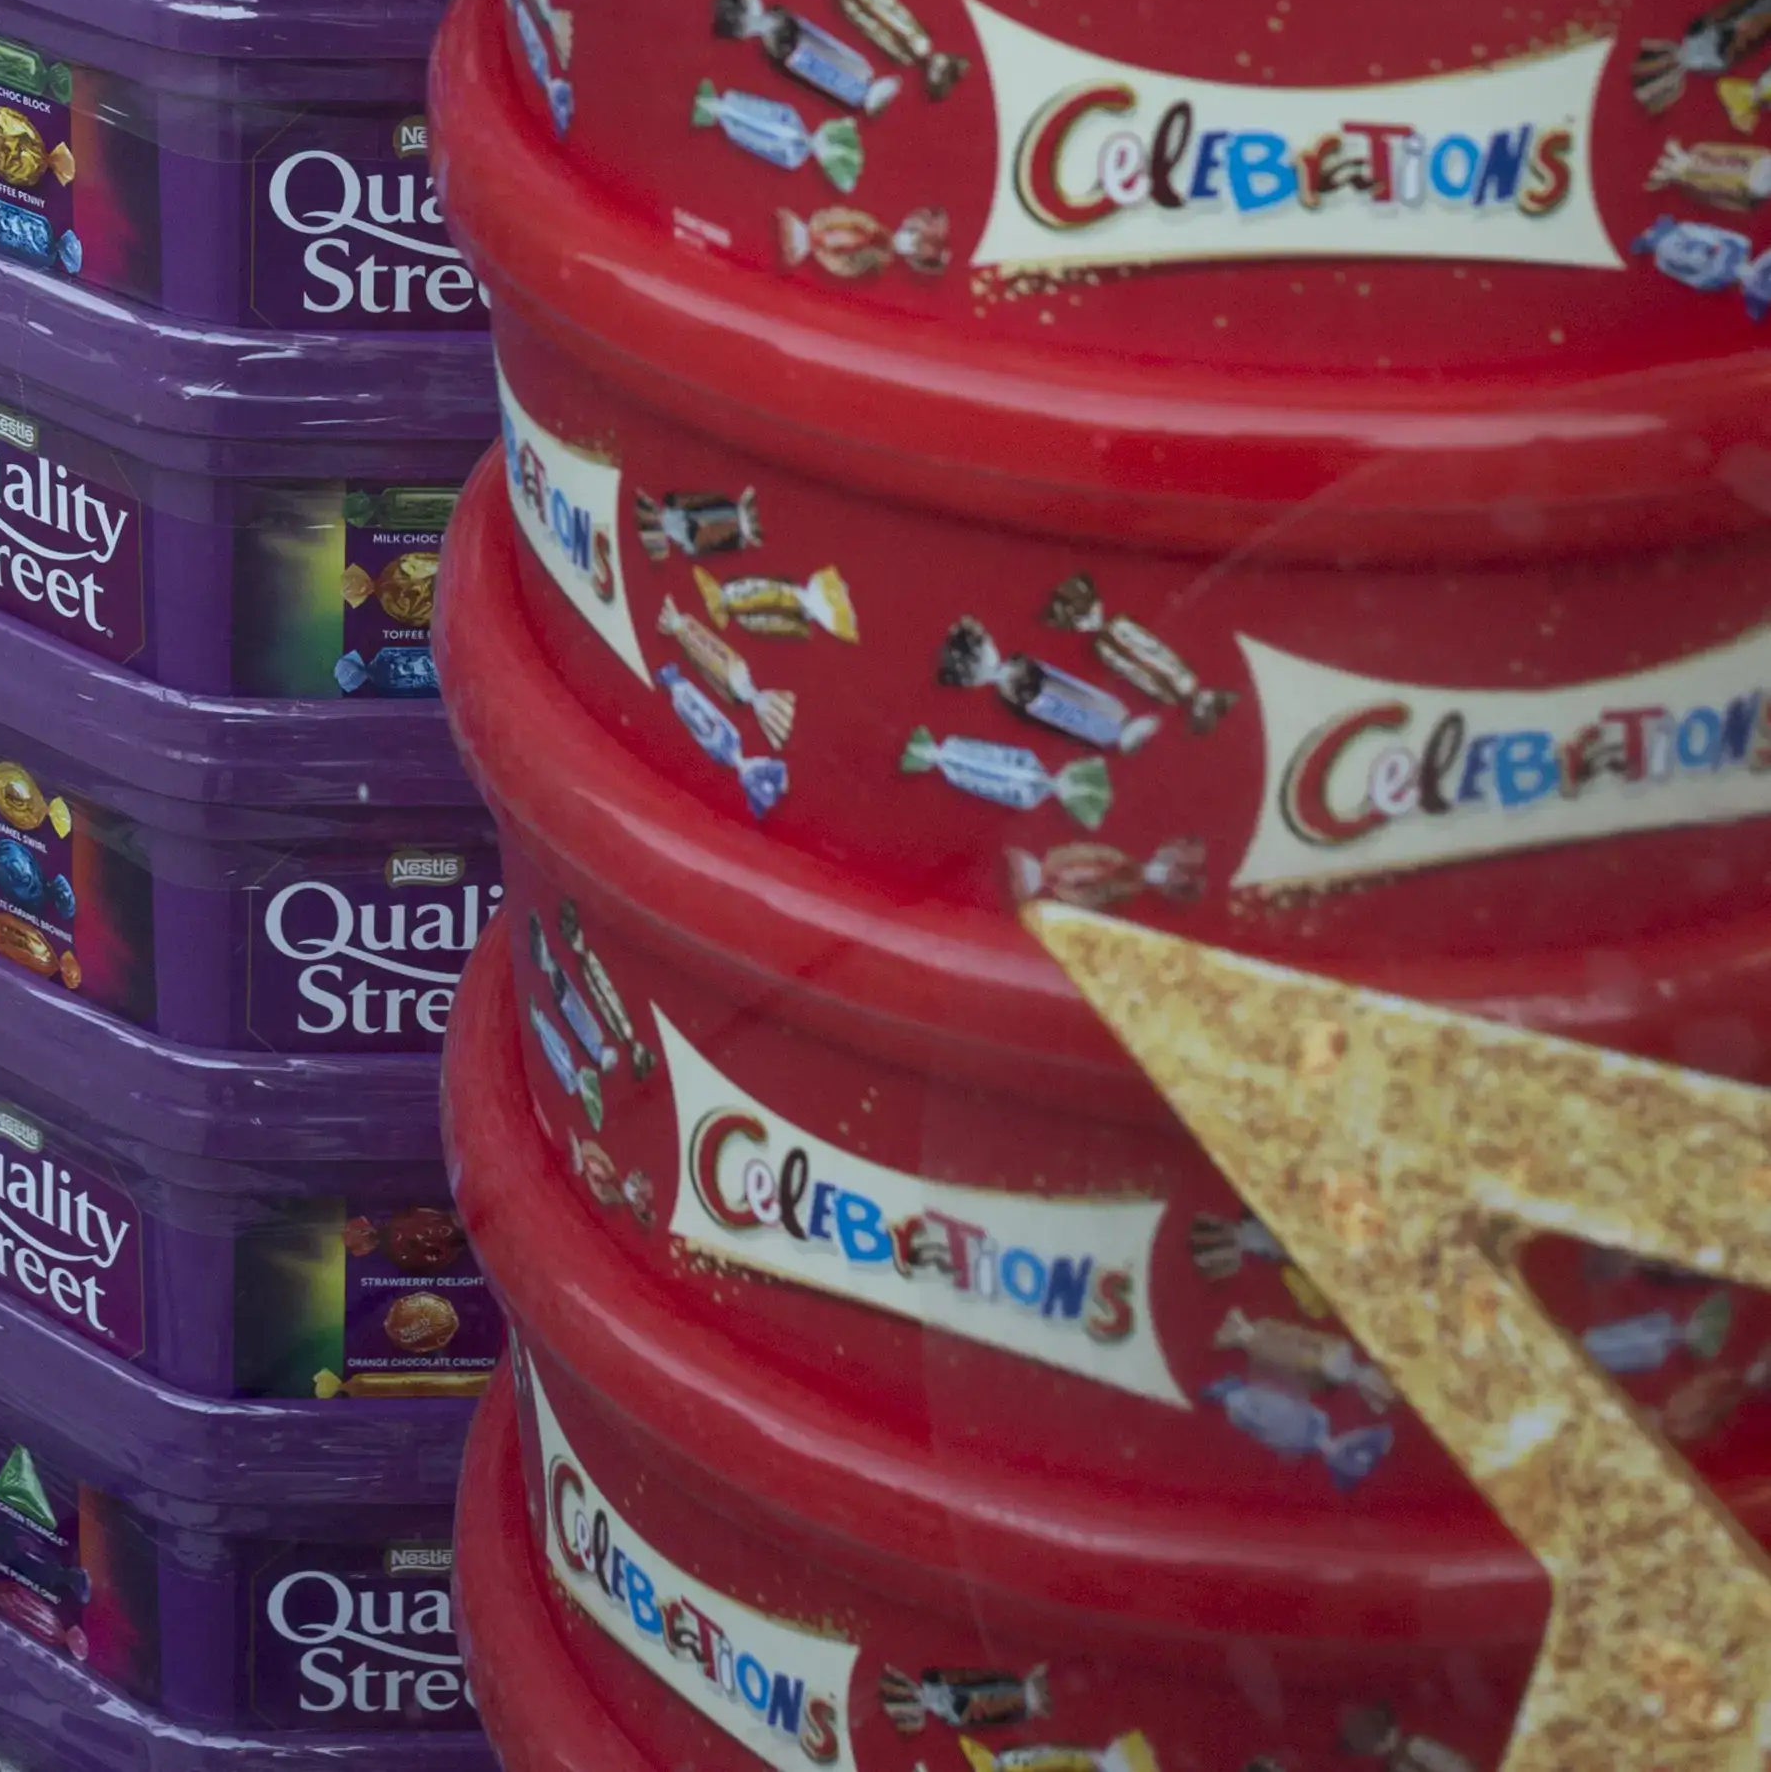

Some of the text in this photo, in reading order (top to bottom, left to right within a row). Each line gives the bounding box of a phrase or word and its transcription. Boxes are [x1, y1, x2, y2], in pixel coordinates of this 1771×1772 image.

[23, 94, 51, 114] BLOCK
[18, 189, 46, 208] PENNY
[372, 533, 438, 545] MILK CHOC
[382, 629, 424, 640] TOFFEE
[22, 831, 47, 853] SWIRL
[8, 901, 40, 928] CARAMEL
[40, 916, 73, 943] BROWNIE
[360, 1275, 485, 1288] STRAWBERRY DELIGHT
[347, 1357, 496, 1369] ORANGE CHOCOLATE CRUNCH
